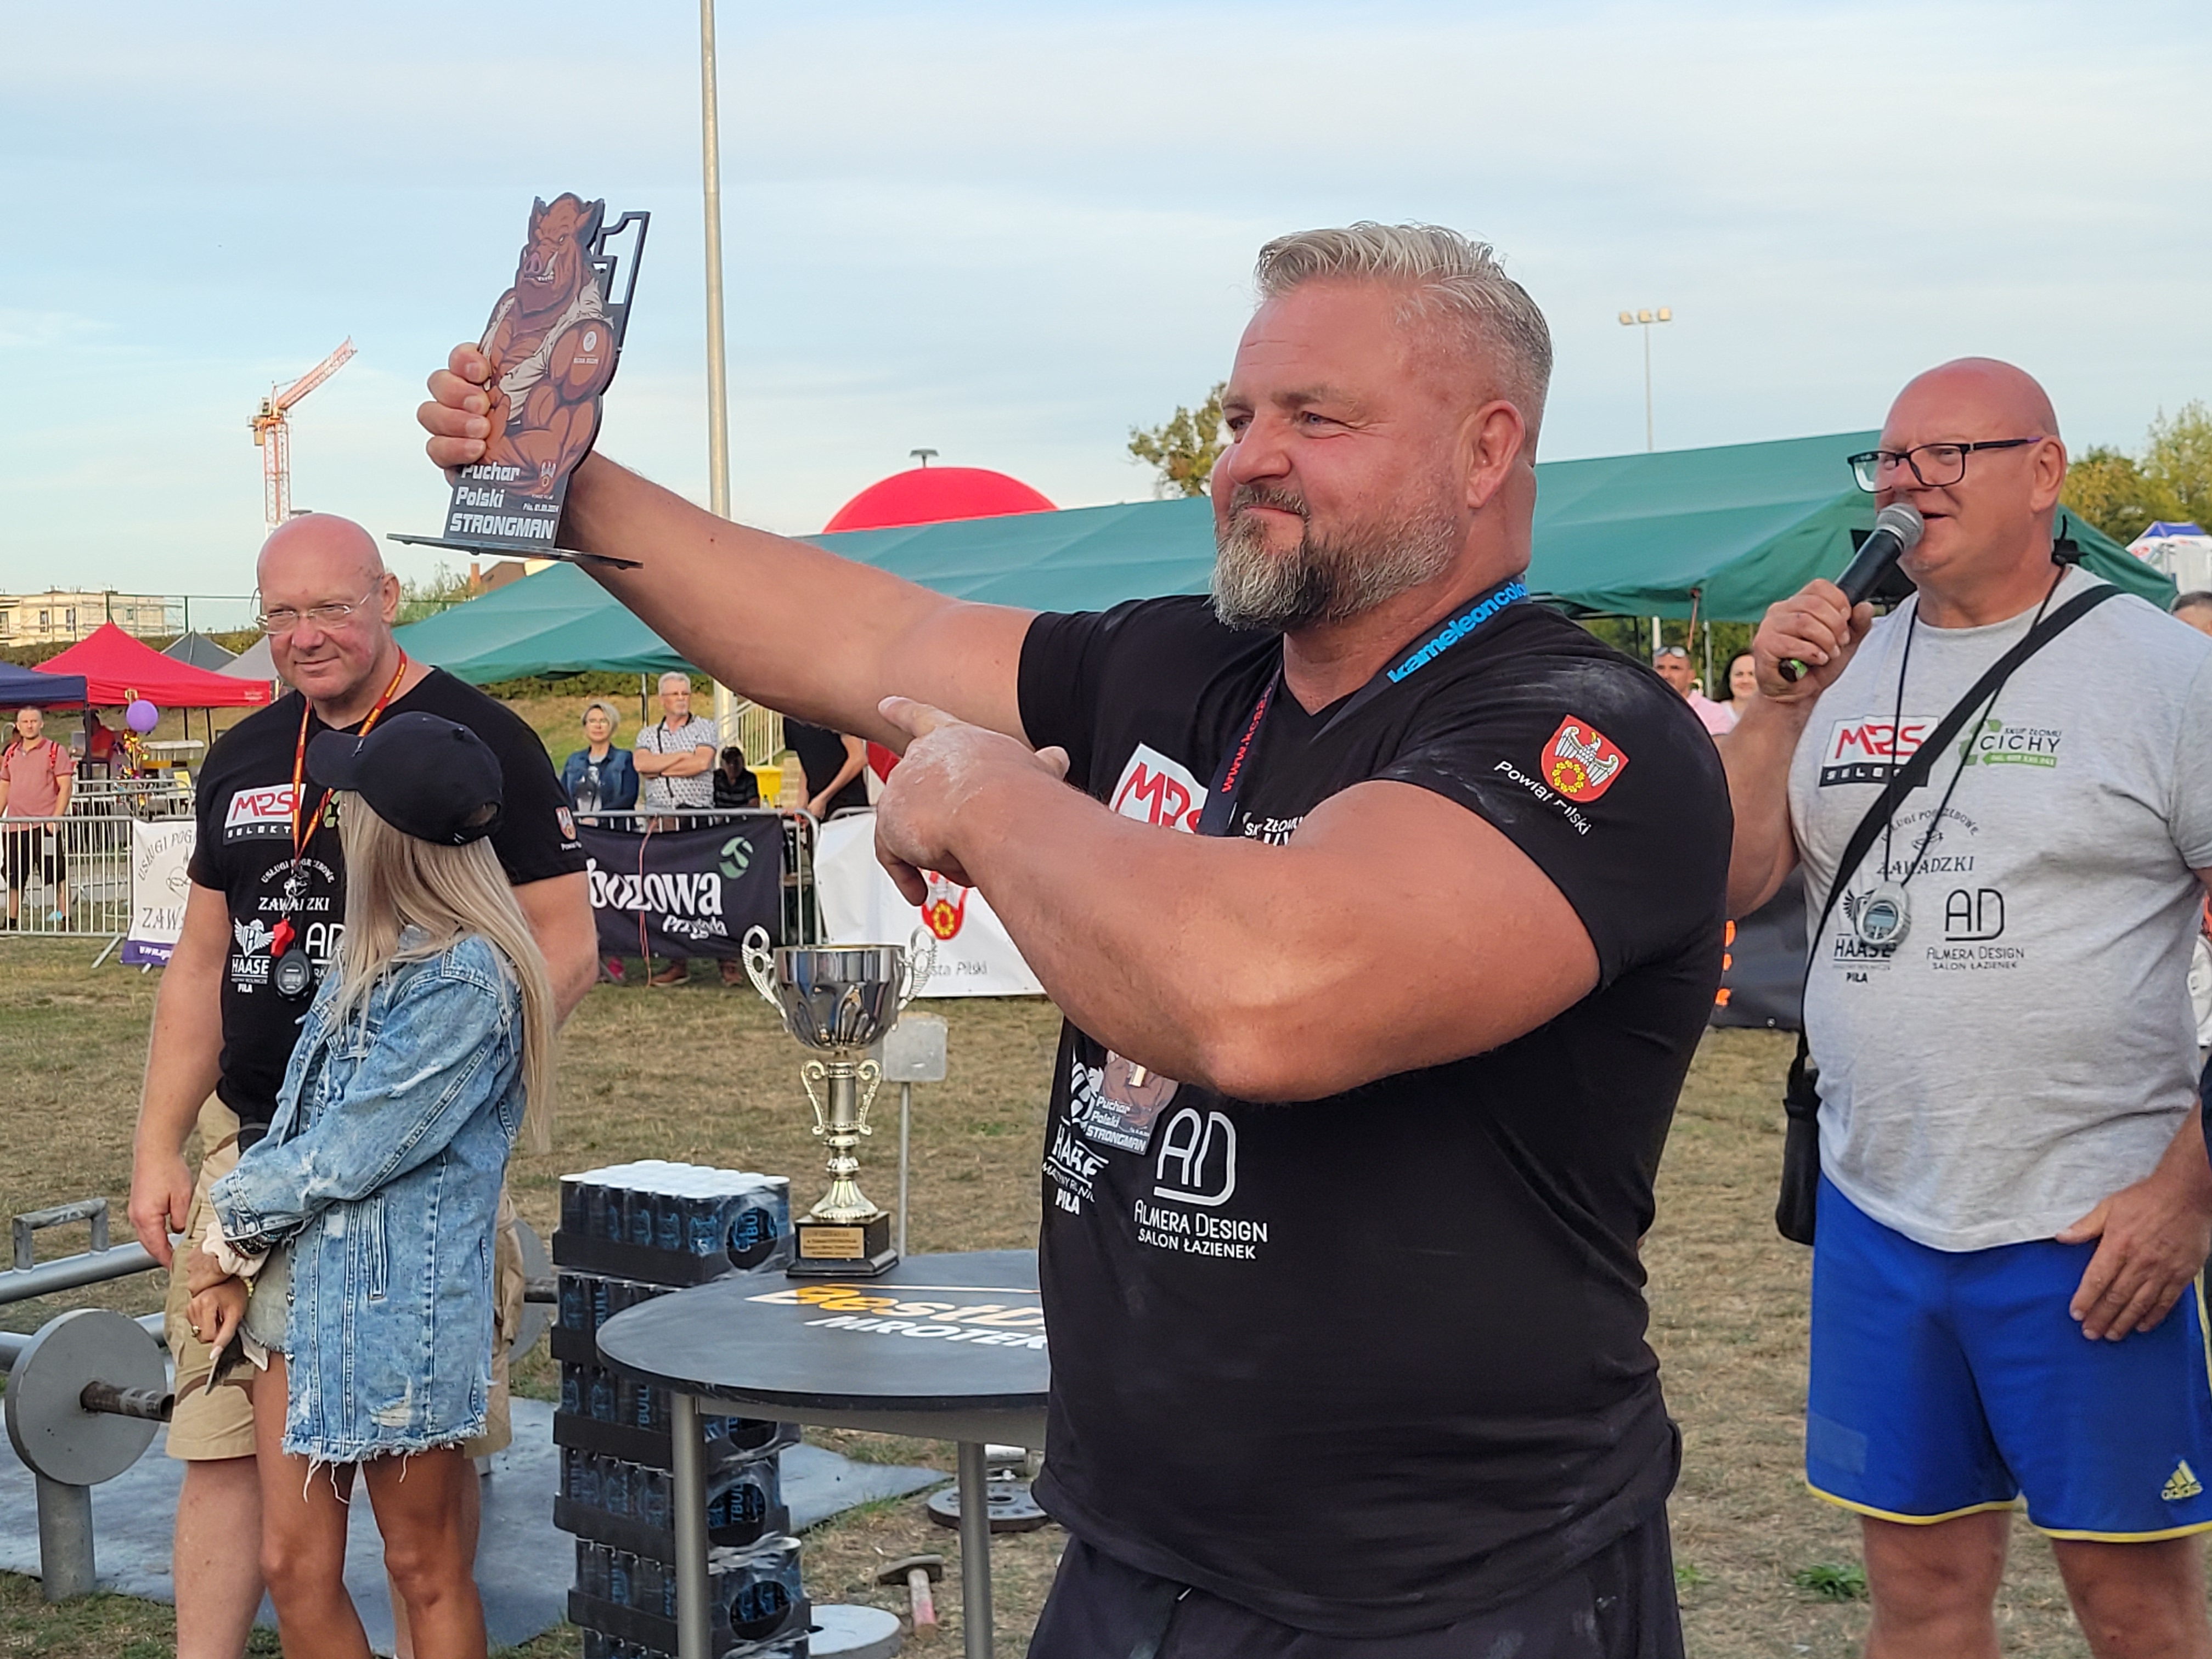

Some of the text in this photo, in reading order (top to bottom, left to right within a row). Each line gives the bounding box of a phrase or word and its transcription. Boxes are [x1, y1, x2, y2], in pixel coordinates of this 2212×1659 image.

[455, 486, 505, 508] Polski
[449, 512, 555, 539] STRONGMAN
[1980, 735, 2061, 753] CICHY
[1494, 761, 1555, 801] Powiat
[1945, 888, 2005, 941] AD
[232, 958, 270, 974] HAASE
[1086, 1125, 1147, 1152] STRONGMAN
[1154, 1108, 1237, 1207] AD
[1134, 1199, 1268, 1243] ALMERA DESIGN
[1138, 1228, 1257, 1259] SALON ŁAZIENEK
